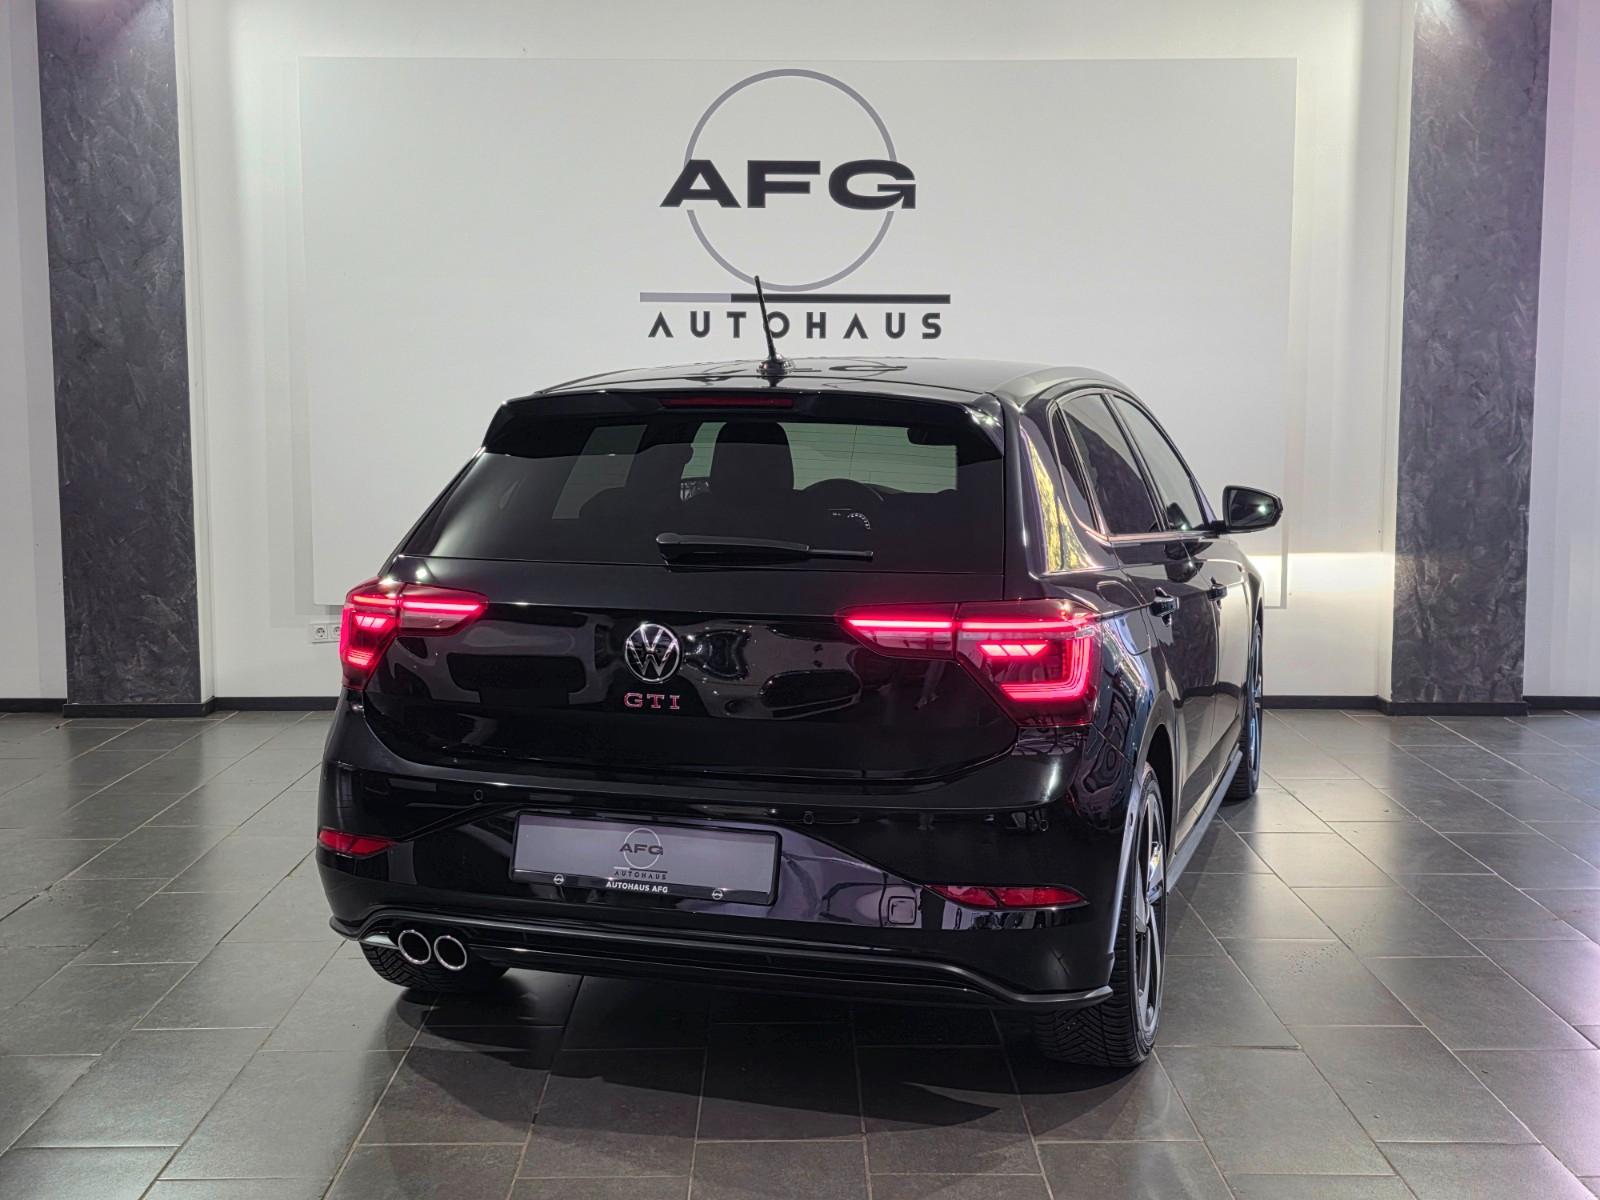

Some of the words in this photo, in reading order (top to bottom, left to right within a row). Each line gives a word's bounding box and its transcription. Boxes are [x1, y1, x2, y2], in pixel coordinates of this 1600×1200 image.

[659, 159, 916, 210] AFG
[648, 311, 942, 339] AUTOHAUS
[624, 692, 681, 710] GTI
[619, 843, 664, 856] AFG
[614, 870, 667, 880] AUTOHAUS
[606, 881, 650, 892] AUTOHAUS
[651, 885, 668, 894] AFG
